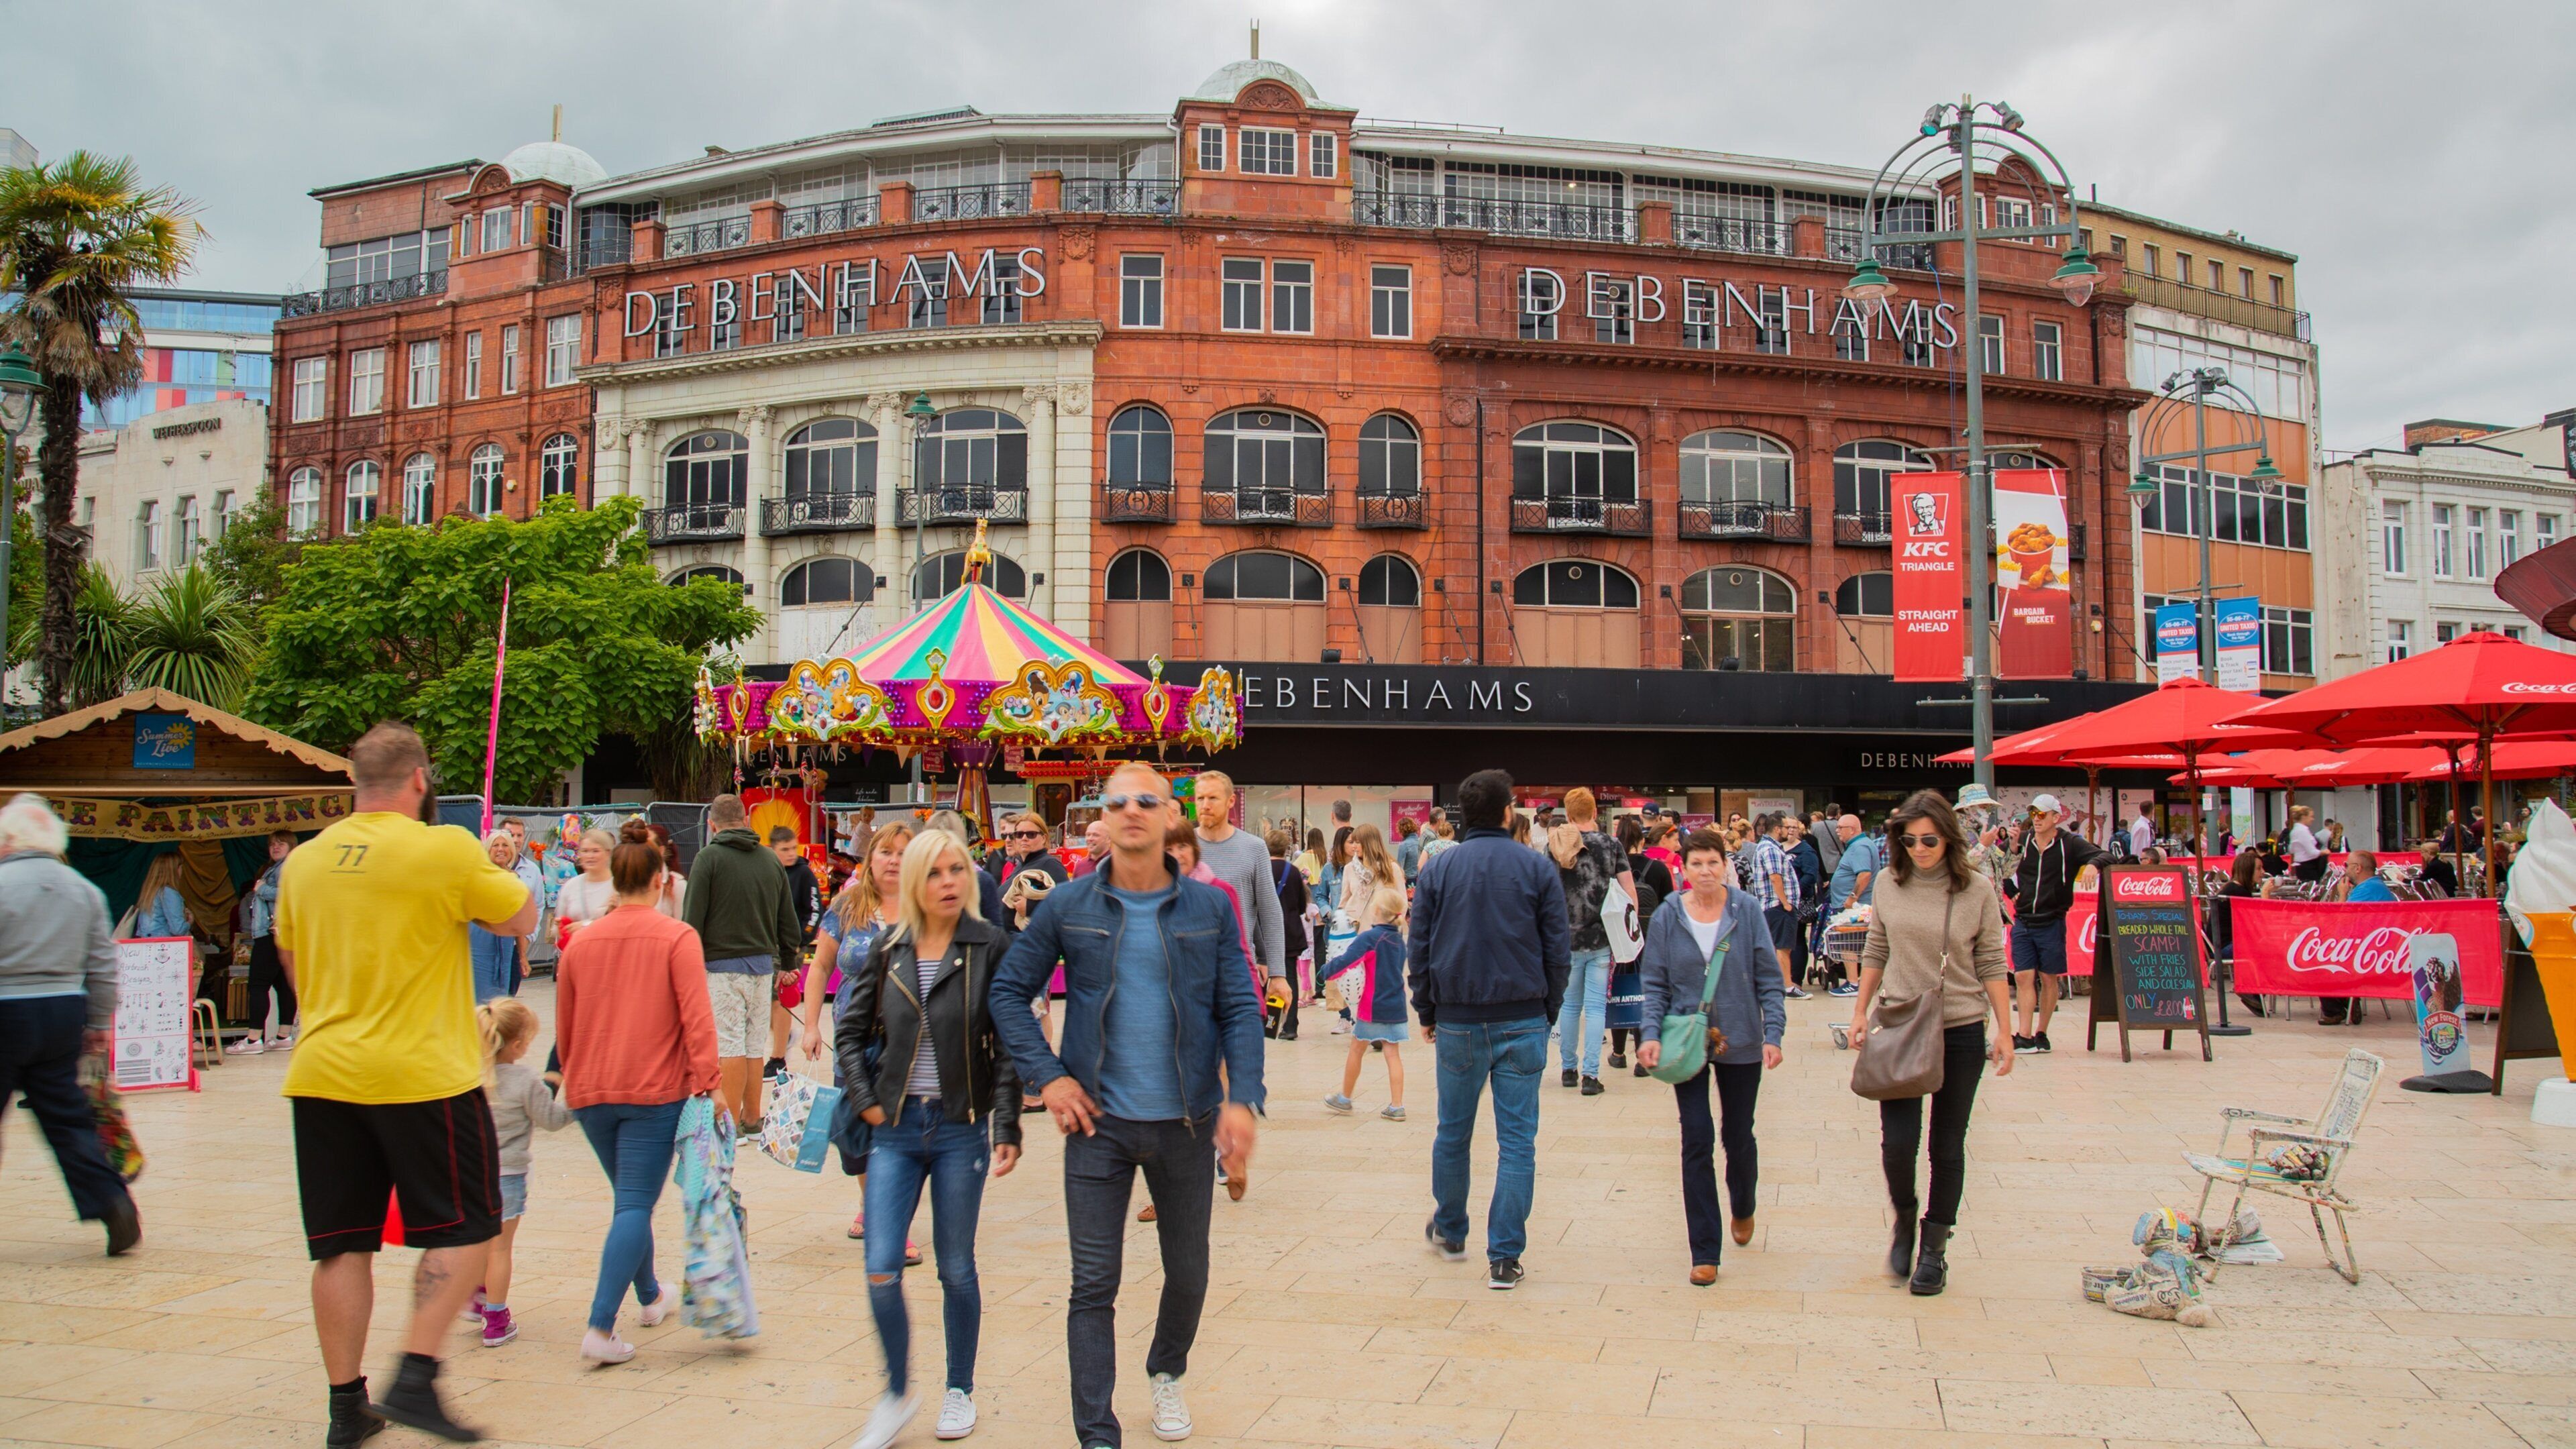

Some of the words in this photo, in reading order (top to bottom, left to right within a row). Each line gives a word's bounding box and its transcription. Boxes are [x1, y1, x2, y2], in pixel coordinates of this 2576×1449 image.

[624, 247, 1046, 338] DEBENHAMS
[1524, 267, 1958, 350] DEBENHAMS
[152, 417, 221, 439] WETHERSPOON
[1902, 541, 1949, 557] KFC
[1900, 562, 1955, 572] TRIANGLE
[1898, 610, 1958, 621] STRAIGHT
[2014, 607, 2045, 616] BARGAIN
[2026, 614, 2055, 625] BUCKET
[1907, 623, 1949, 633] AHEAD
[2159, 629, 2178, 637] UNITED
[2178, 627, 2194, 636] TAXIS
[2220, 623, 2239, 632] UNITED
[2240, 622, 2255, 630] TAXIS
[1244, 677, 1532, 712] EBENHAMS
[137, 728, 184, 744] Summer
[151, 740, 180, 757] Live
[115, 795, 345, 833] PAINTING
[2118, 876, 2175, 896] Coca-Cola
[2118, 925, 2147, 935] BREADED
[2149, 924, 2173, 935] WHOLE
[2174, 924, 2189, 935] TAIL
[2134, 936, 2180, 952] SCAMPI
[119, 945, 140, 958] New
[2129, 954, 2157, 965] WITH
[2160, 954, 2186, 965] FRIES
[2135, 966, 2156, 977] SIDE
[2159, 966, 2187, 977] SALAD
[2138, 979, 2160, 989] AND
[2161, 979, 2196, 989] COLESLAW
[1606, 996, 1621, 1004] JOHN
[1621, 994, 1646, 1003] ANTHON
[2125, 992, 2157, 1010] ONLY
